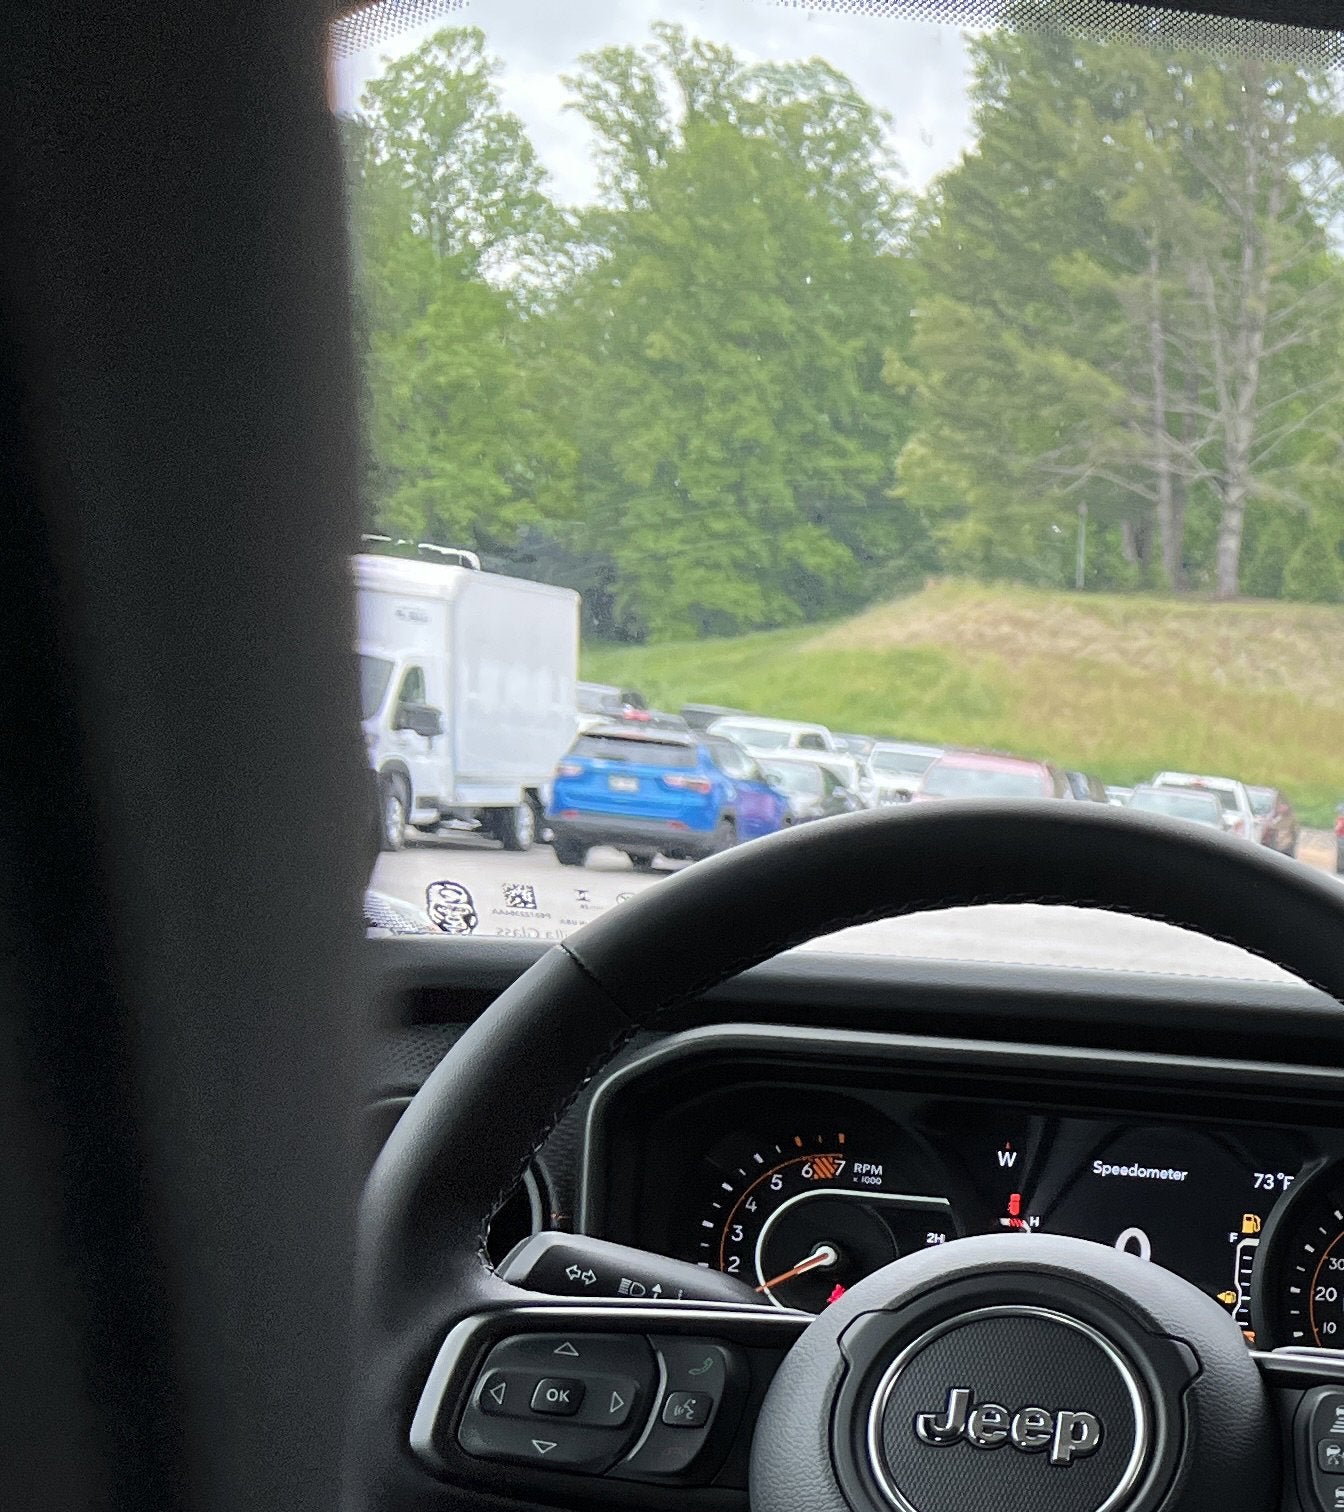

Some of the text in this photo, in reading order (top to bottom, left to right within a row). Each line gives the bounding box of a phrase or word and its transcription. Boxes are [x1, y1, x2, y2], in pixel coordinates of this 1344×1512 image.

[997, 1150, 1017, 1168] W
[801, 1162, 814, 1178] 6
[834, 1160, 847, 1177] 7
[853, 1162, 883, 1177] RPM
[1092, 1159, 1189, 1182] Speedometer
[770, 1174, 784, 1191] 5
[1253, 1171, 1296, 1191] 73°F
[745, 1196, 758, 1213] 4
[1029, 1215, 1040, 1227] H
[730, 1224, 744, 1242] 3
[1228, 1232, 1239, 1244] F
[727, 1256, 740, 1273] 2
[1315, 1286, 1338, 1302] 20
[1322, 1321, 1337, 1335] 10
[545, 1388, 571, 1403] OK
[916, 1387, 1103, 1467] Jeep
